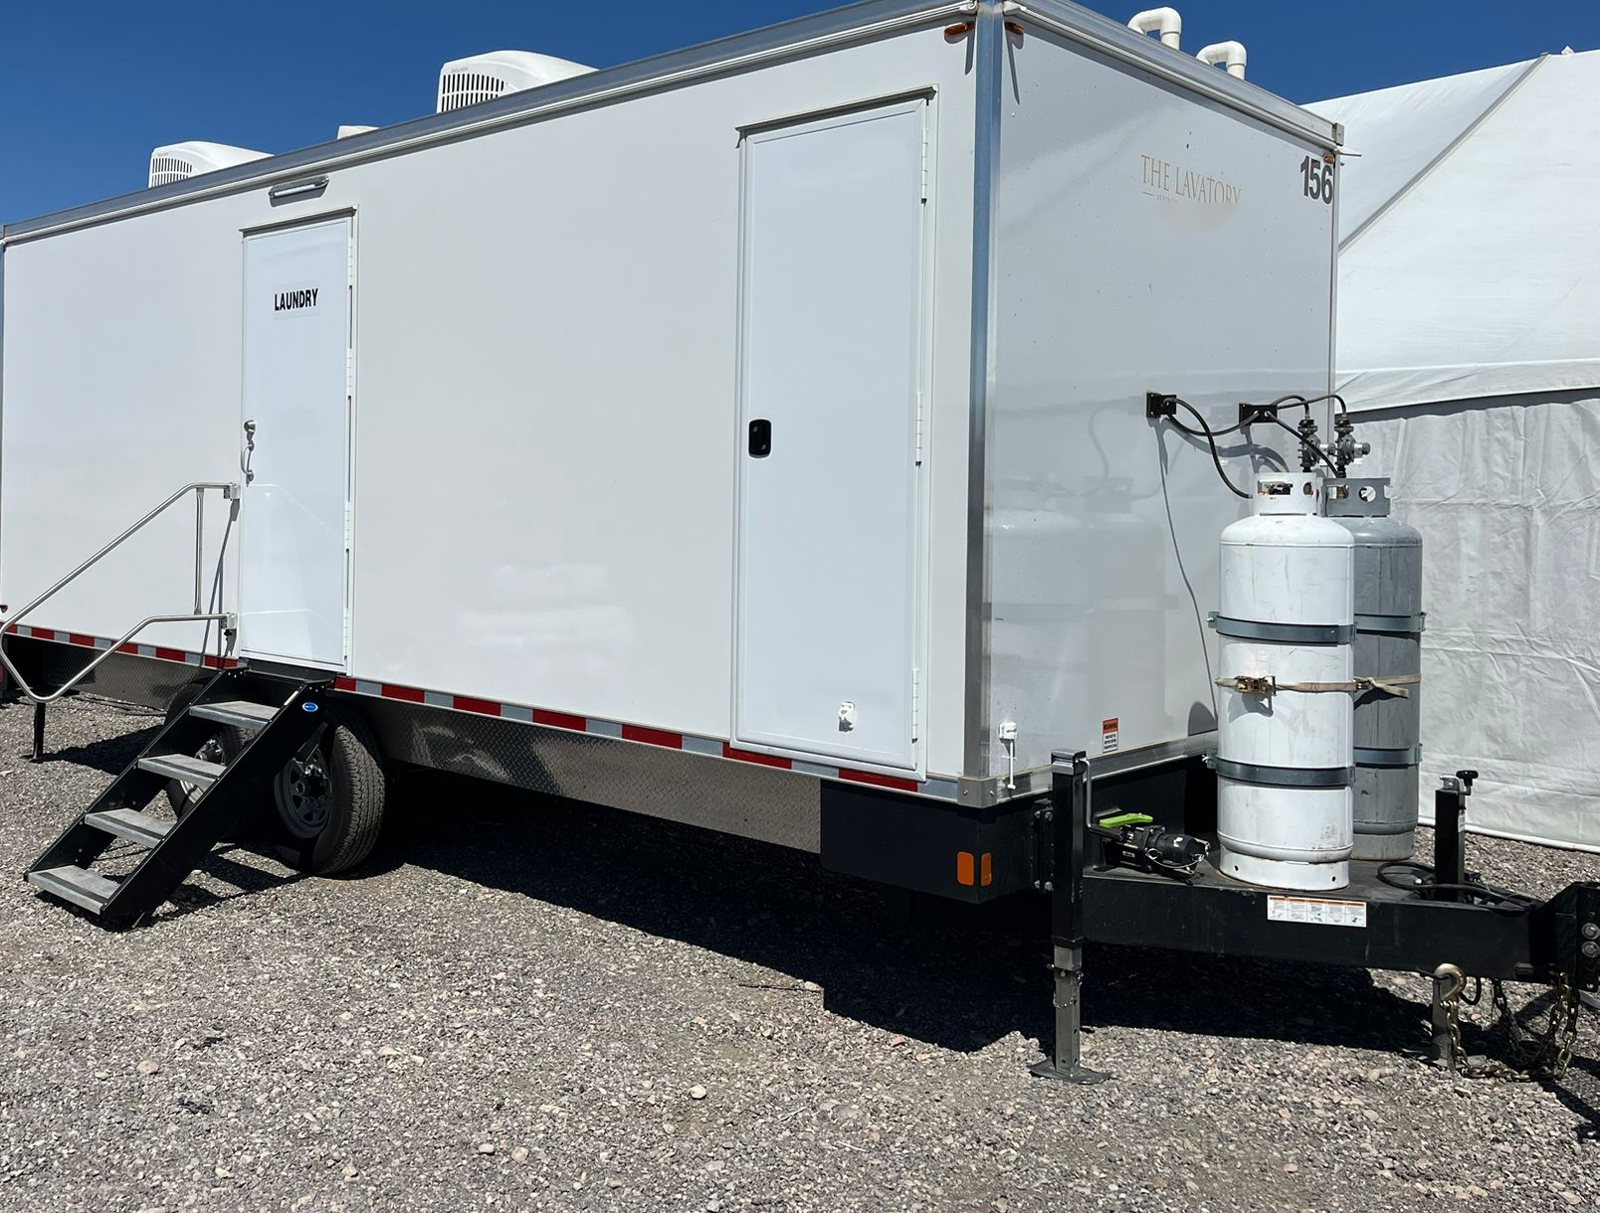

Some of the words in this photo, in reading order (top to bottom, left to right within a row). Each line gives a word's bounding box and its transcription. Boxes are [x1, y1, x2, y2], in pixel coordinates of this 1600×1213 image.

[1141, 154, 1170, 191] THE
[1175, 167, 1241, 203] LAVATORY
[1300, 156, 1333, 204] 156
[274, 288, 319, 311] LAUNDRY
